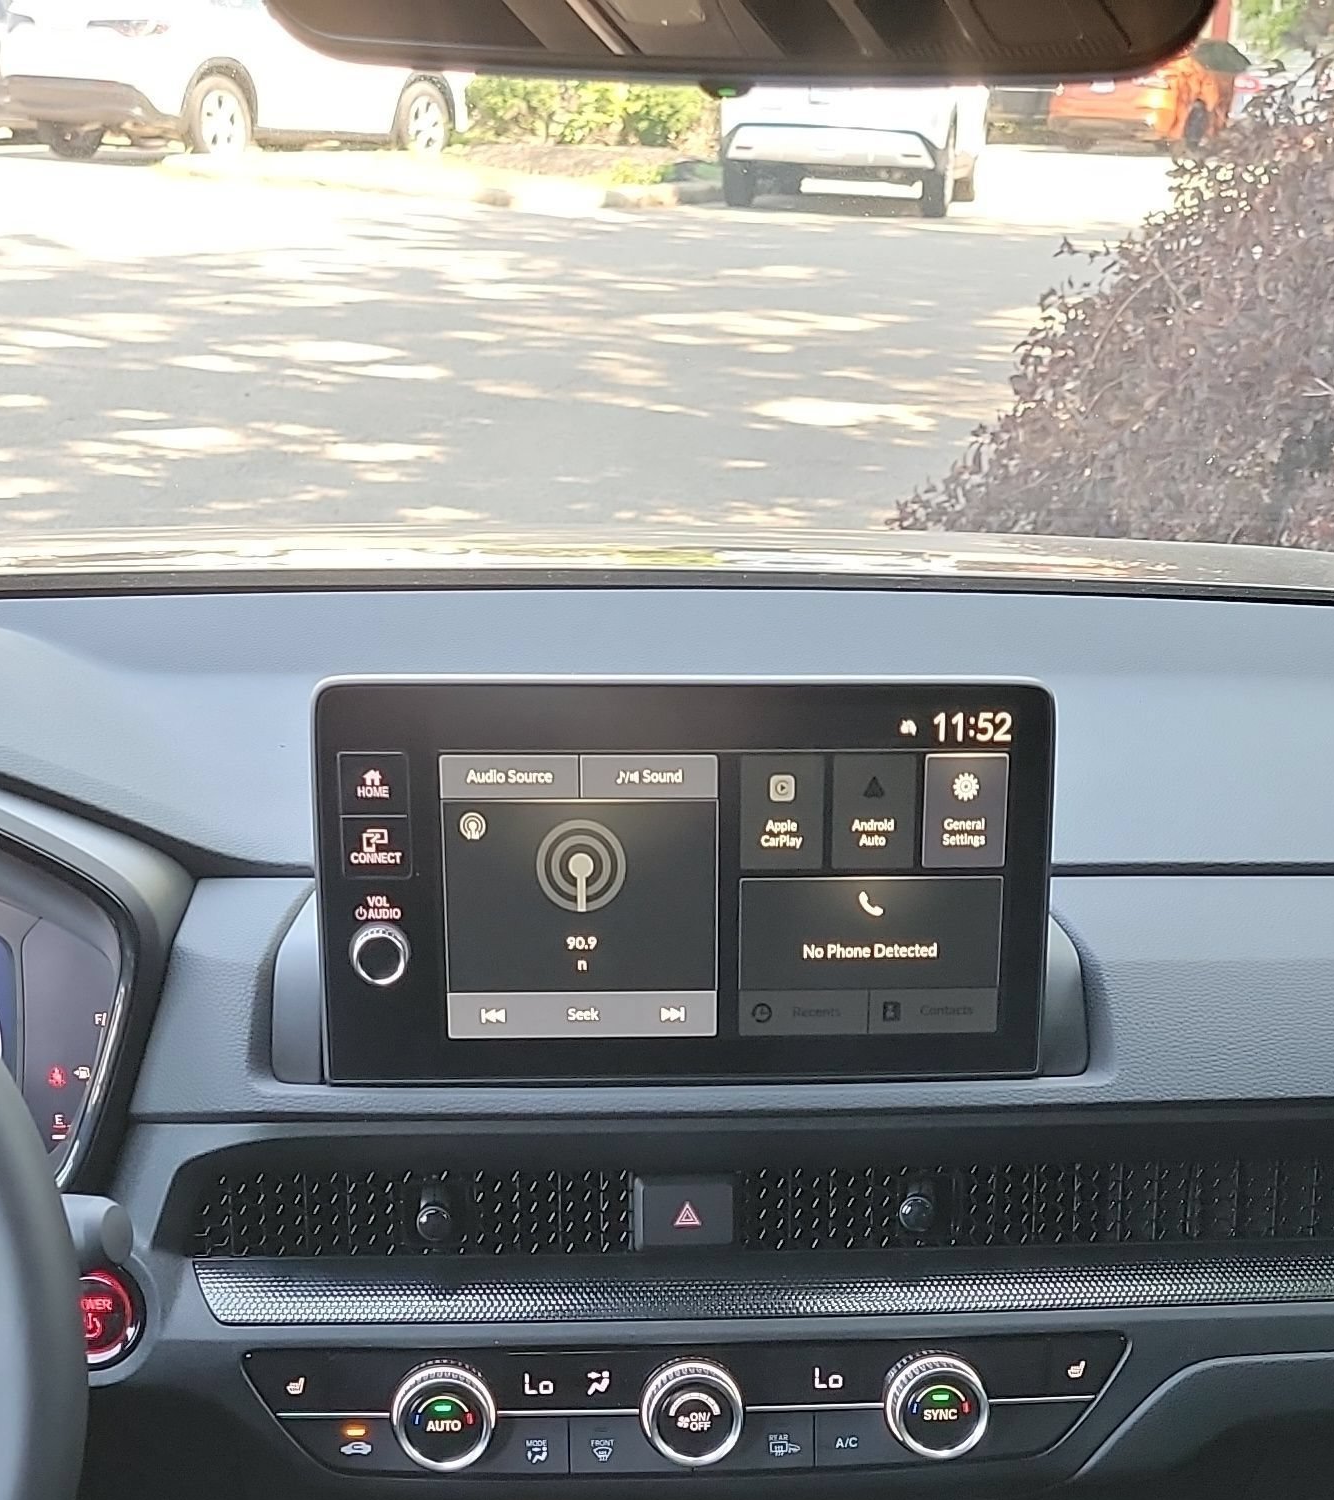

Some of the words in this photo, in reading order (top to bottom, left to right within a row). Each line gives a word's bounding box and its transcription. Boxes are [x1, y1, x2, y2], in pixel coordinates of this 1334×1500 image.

[933, 711, 1013, 743] 11:52
[466, 769, 506, 784] Audio
[507, 769, 554, 784] Source
[641, 768, 683, 784] Sound
[356, 786, 390, 798] HOME
[765, 819, 798, 834] Apple
[851, 818, 895, 832] Android
[943, 817, 986, 831] General
[760, 834, 803, 849] CarPlay
[858, 834, 887, 847] Auto
[942, 833, 986, 848] Settings
[350, 852, 402, 864] CONNECT
[366, 895, 390, 907] VOL
[367, 908, 402, 919] AUDIO
[566, 936, 598, 950] 90.9
[802, 943, 825, 959] No
[826, 943, 872, 959] Phone
[873, 942, 938, 959] Detected
[577, 959, 588, 971] n
[567, 1007, 599, 1021] Seek
[792, 1006, 841, 1018] Recents
[920, 1004, 974, 1017] Contacts
[524, 1372, 554, 1395] Lo
[814, 1367, 844, 1389] Lo
[923, 1408, 958, 1421] SYNC
[426, 1419, 462, 1432] AUTO
[689, 1421, 711, 1432] OFF
[525, 1439, 548, 1447] MODE
[590, 1439, 615, 1447] FRONT
[835, 1437, 859, 1449] A/C
